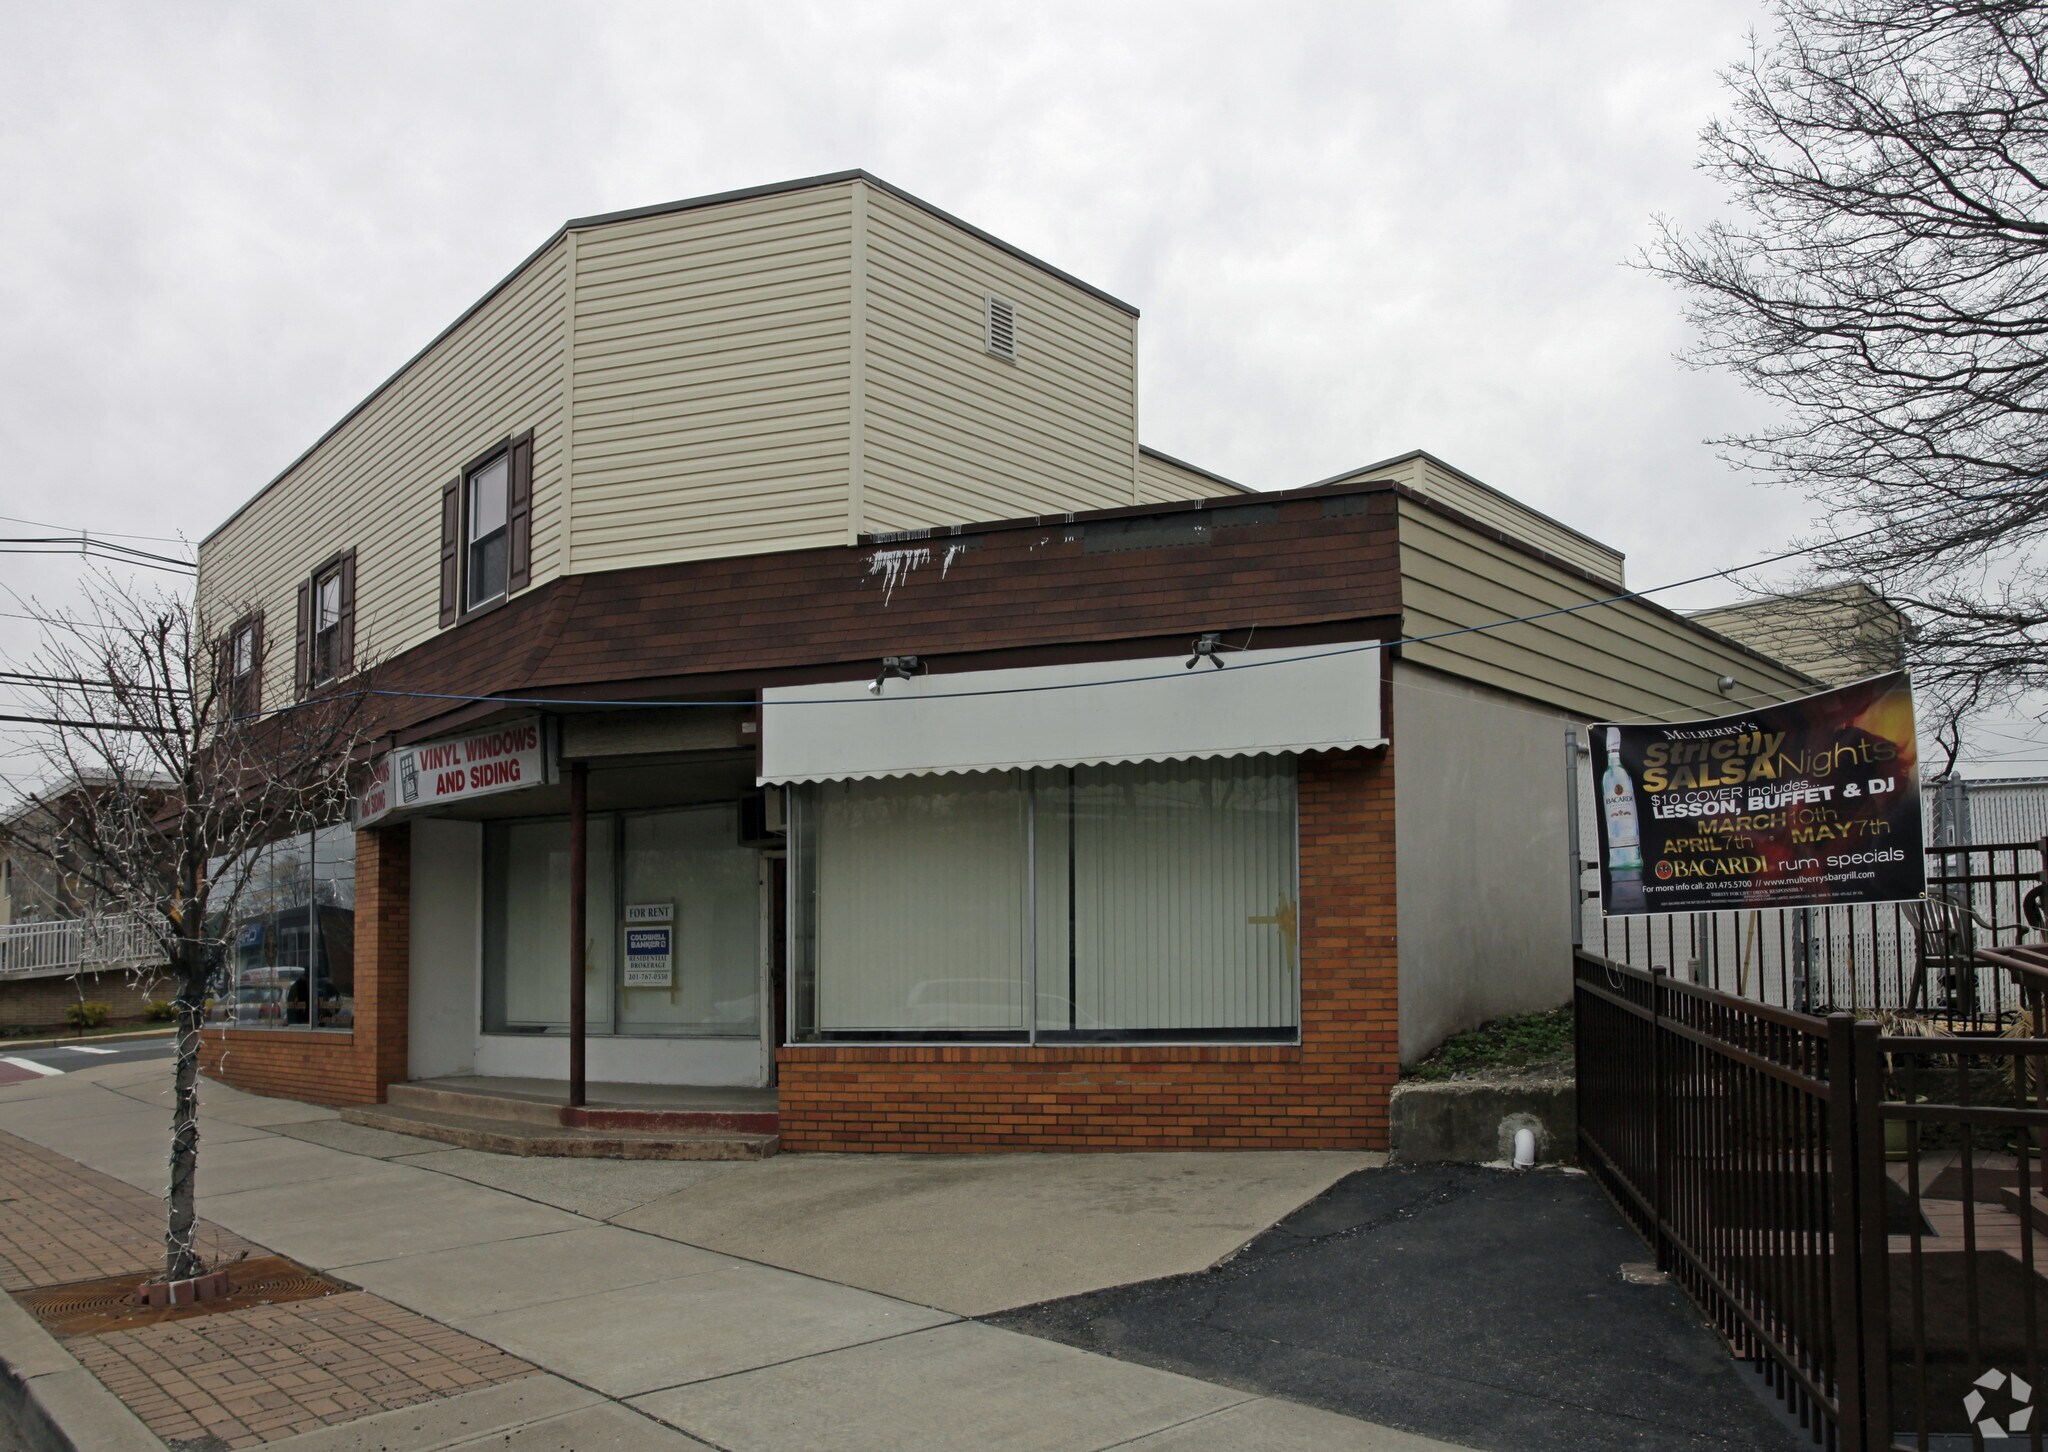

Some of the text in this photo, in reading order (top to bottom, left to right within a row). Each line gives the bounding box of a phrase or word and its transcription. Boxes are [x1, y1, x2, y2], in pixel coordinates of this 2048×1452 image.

[1662, 722, 1759, 740] MULBERRY'S
[419, 726, 538, 772] VINYL WINDOWS
[1643, 731, 1786, 768] Strictly
[435, 758, 521, 796] AND SIDING
[1642, 738, 1897, 793] SALSA Nights
[1605, 796, 1633, 805] BACARDI
[1651, 780, 1820, 807] $10 COVER includes...
[1652, 776, 1896, 819] LESSON, BUFFET & DJ
[1697, 806, 1838, 835] MARCH 10th
[1663, 818, 1891, 854] APRIL 7th MAY 7th
[1673, 846, 1905, 878] BACARDI rum specials
[1642, 885, 1654, 893] For
[1675, 882, 1690, 891] info
[1690, 882, 1705, 890] call:
[1705, 880, 1753, 890] 201.475.5700
[1763, 870, 1876, 887] www.mulberrysbargrill.com
[629, 906, 670, 918] FOR RENT
[630, 933, 666, 941] COLDWELL
[630, 941, 660, 949] BANKER
